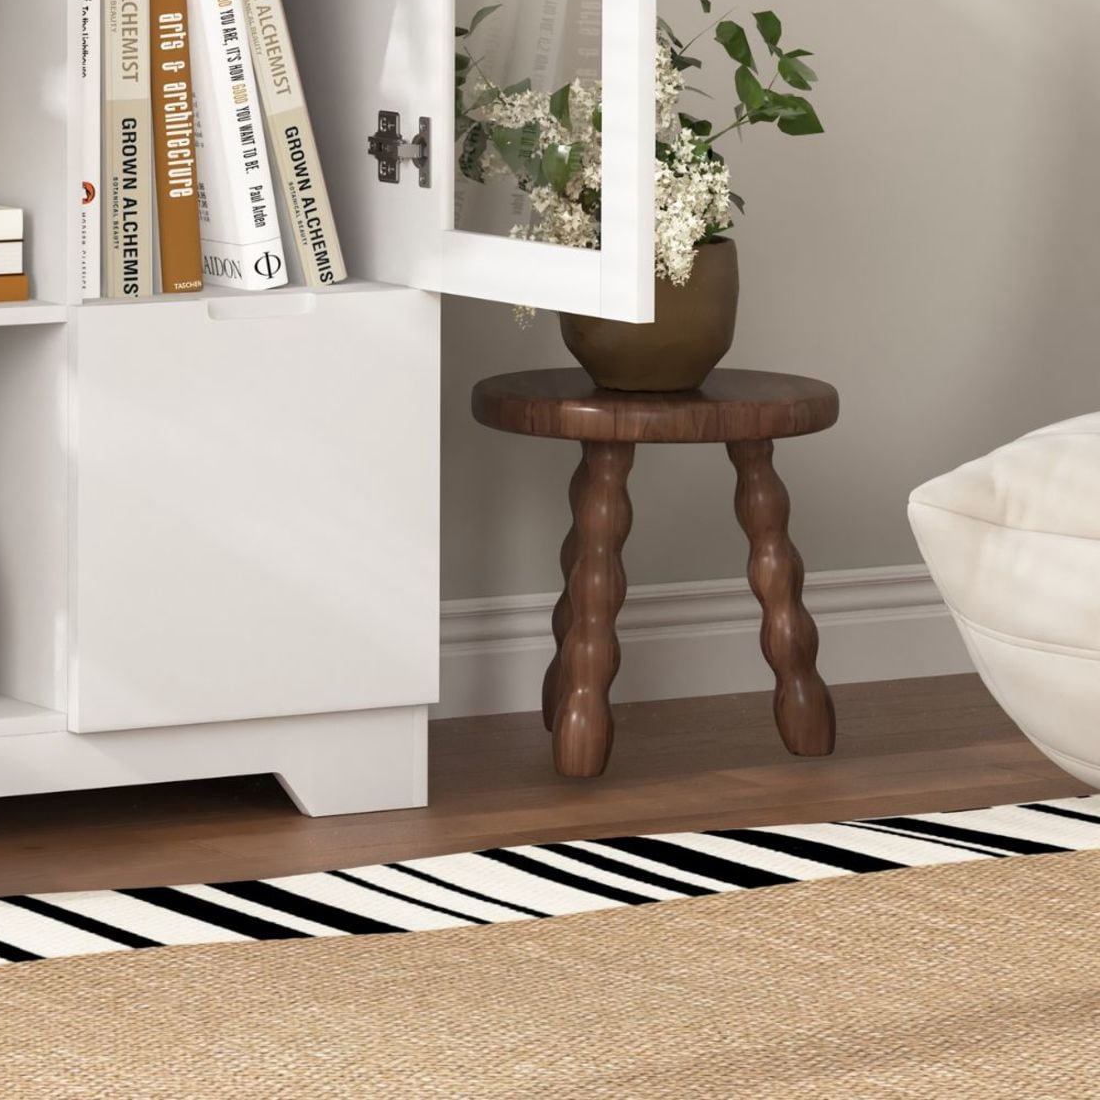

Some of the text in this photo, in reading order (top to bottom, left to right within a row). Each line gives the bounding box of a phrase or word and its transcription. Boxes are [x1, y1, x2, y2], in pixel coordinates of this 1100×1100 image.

[219, 8, 236, 26] YOU
[158, 12, 187, 50] arts
[222, 27, 238, 46] ARE,
[226, 47, 242, 64] IT'S
[256, 5, 291, 95] ALCHEMIST
[228, 63, 245, 82] HOW
[231, 83, 249, 105] GOOD
[236, 105, 252, 122] YOU
[163, 81, 194, 198] architecture
[238, 123, 256, 147] WANT
[243, 147, 258, 159] TO
[245, 159, 260, 174] BE.
[249, 184, 265, 204] Paul
[284, 125, 334, 284] GROWN ALCHEMIS
[121, 117, 139, 297] GROWN ALCHEMIS
[252, 204, 266, 228] Arden
[288, 181, 308, 246] BOTANICAL BEAUTY
